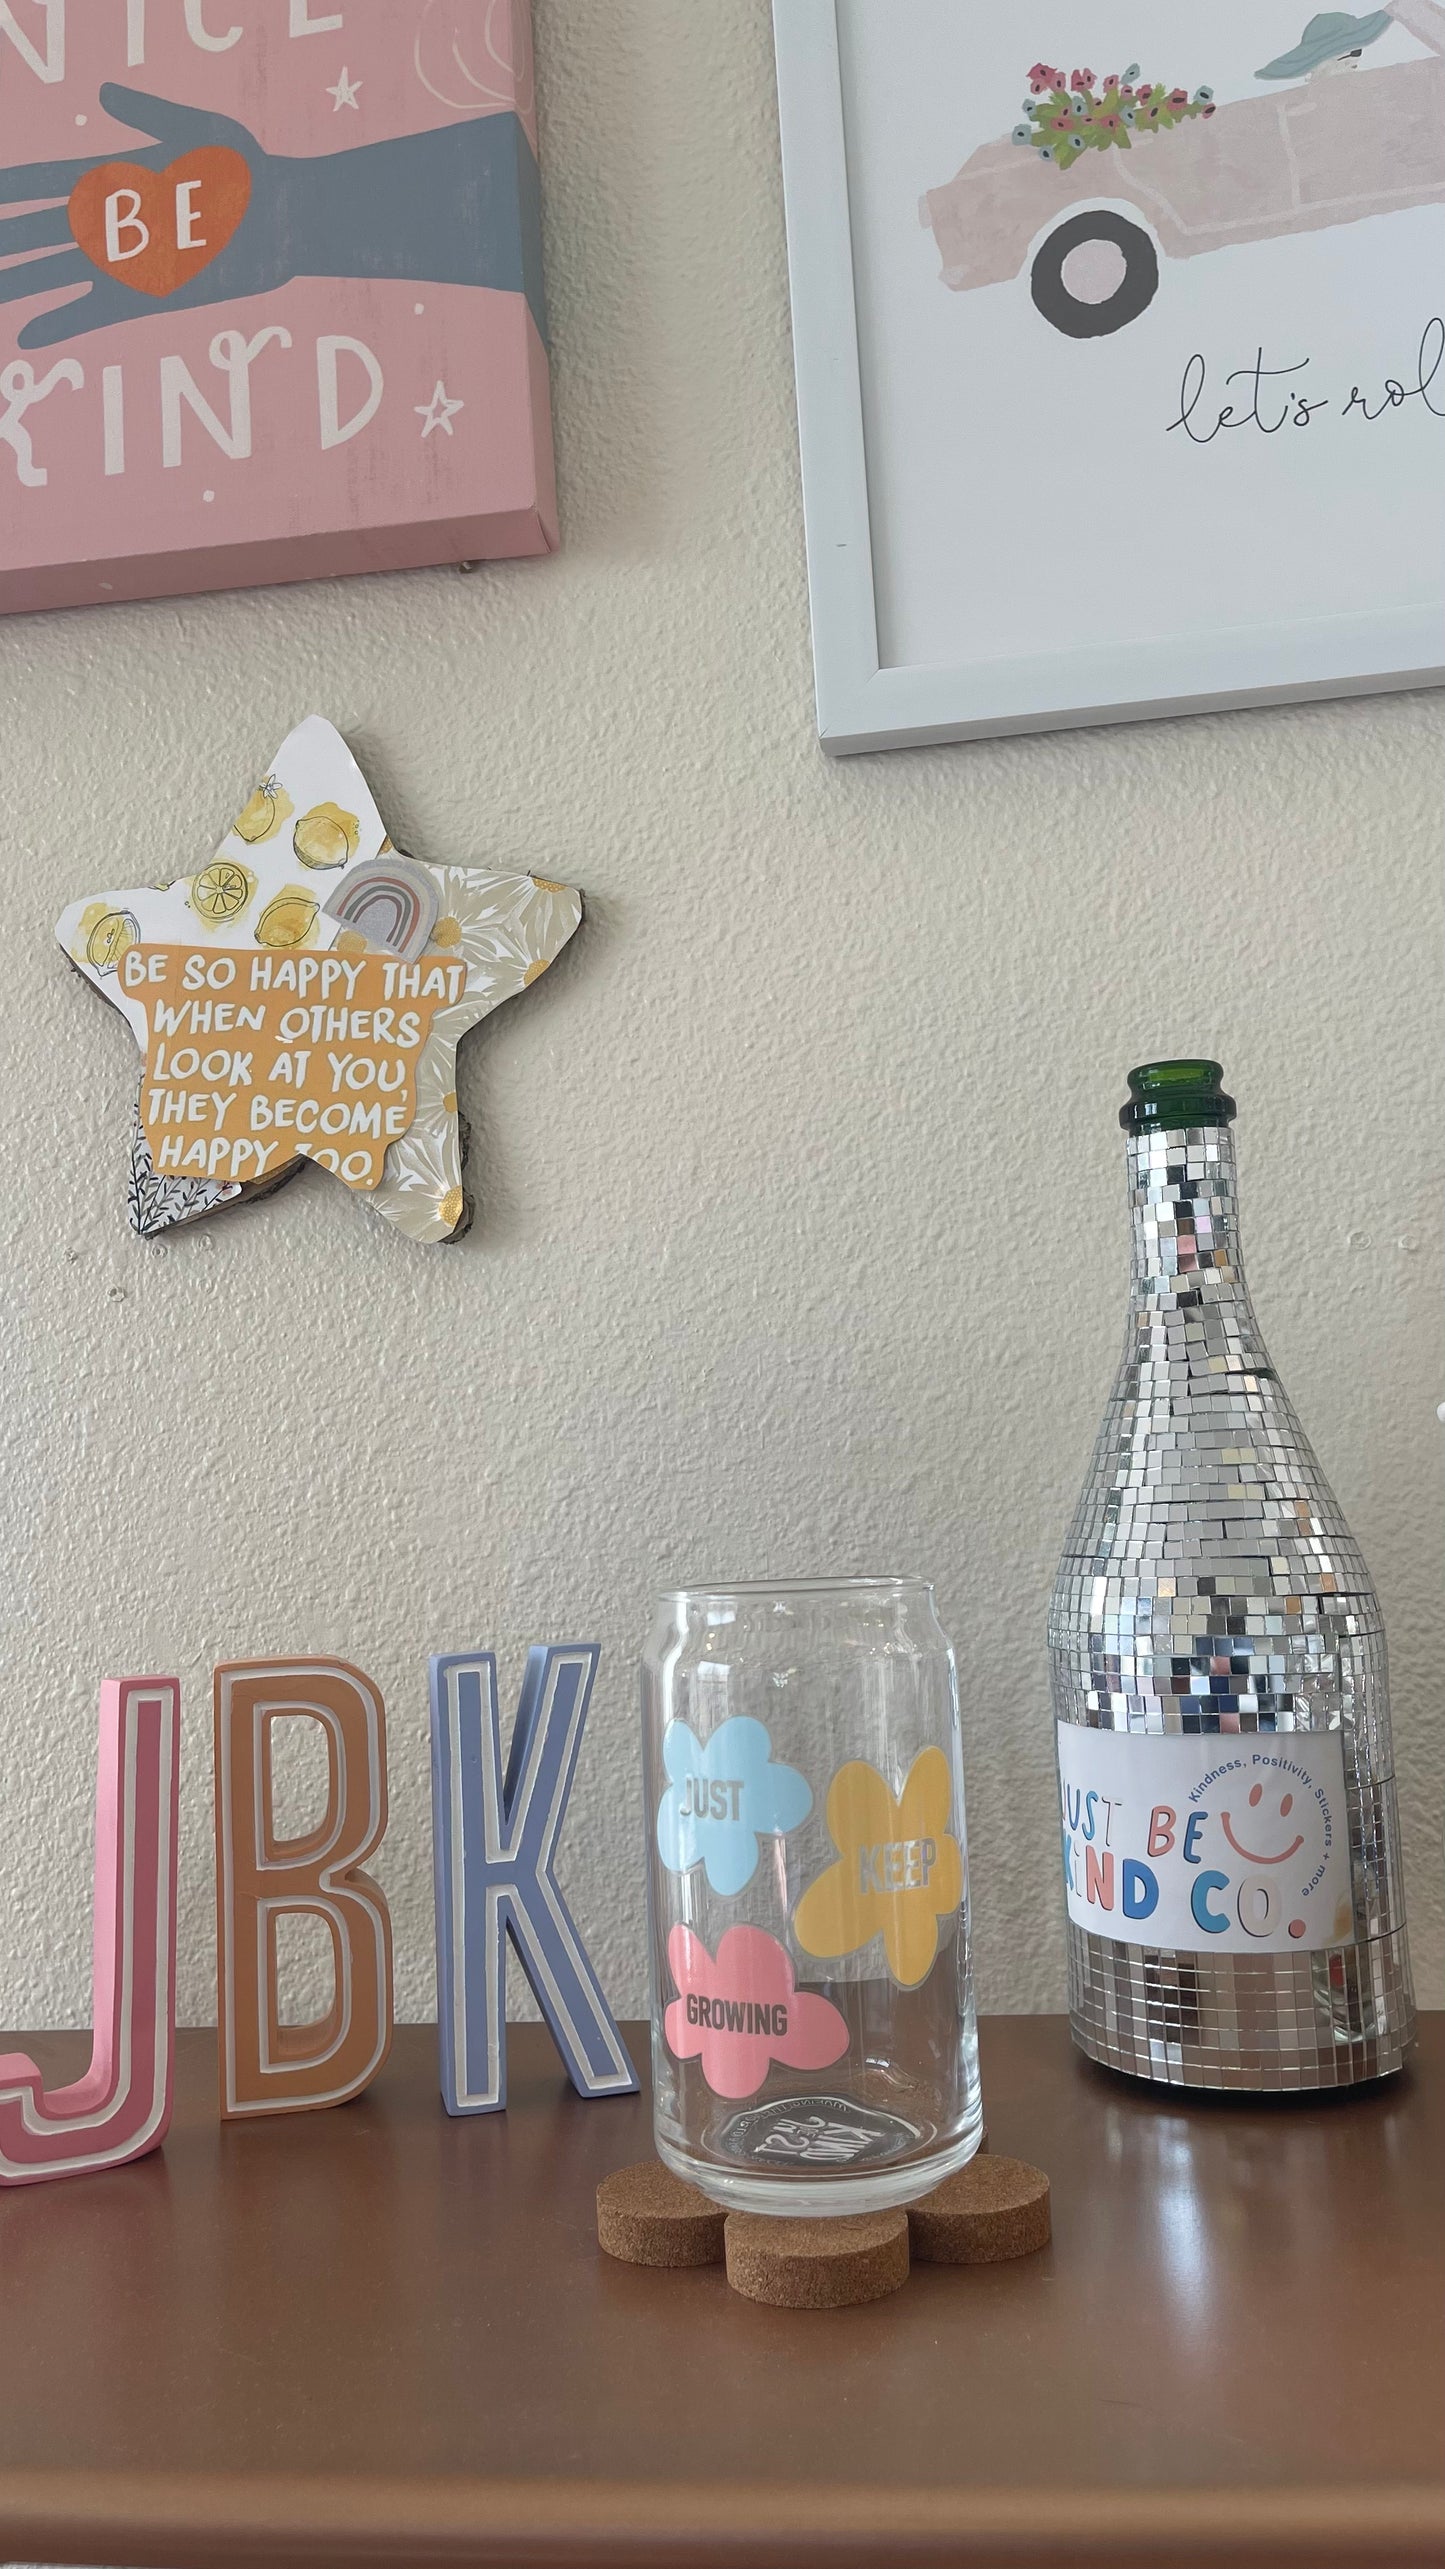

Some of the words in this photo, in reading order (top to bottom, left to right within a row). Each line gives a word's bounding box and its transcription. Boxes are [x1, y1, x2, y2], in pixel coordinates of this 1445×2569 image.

[105, 180, 206, 262] BE
[1166, 347, 1328, 443] let's
[124, 951, 168, 987] BE
[182, 956, 236, 991] SO
[250, 956, 366, 999] HAPPY
[382, 963, 465, 1004] THAT
[152, 999, 266, 1036] WHEN
[276, 1005, 421, 1048] OTHERS
[152, 1042, 253, 1086] LOOK
[269, 1052, 310, 1088] AT
[328, 1053, 408, 1101] YOU,
[147, 1089, 237, 1130] THEY
[250, 1095, 407, 1138] BECOME
[158, 1136, 279, 1177] HAPPY
[680, 1773, 744, 1820] JUST
[1188, 1759, 1247, 1803] Kindness,
[1252, 1754, 1312, 1789] Positivity,
[1147, 1805, 1208, 1865] BE
[1314, 1788, 1332, 1847] Stickers
[859, 1837, 937, 1894] KEEP
[1301, 1865, 1326, 1896] more
[1191, 1870, 1306, 1938] CO.
[686, 1993, 788, 2036] GROWING
